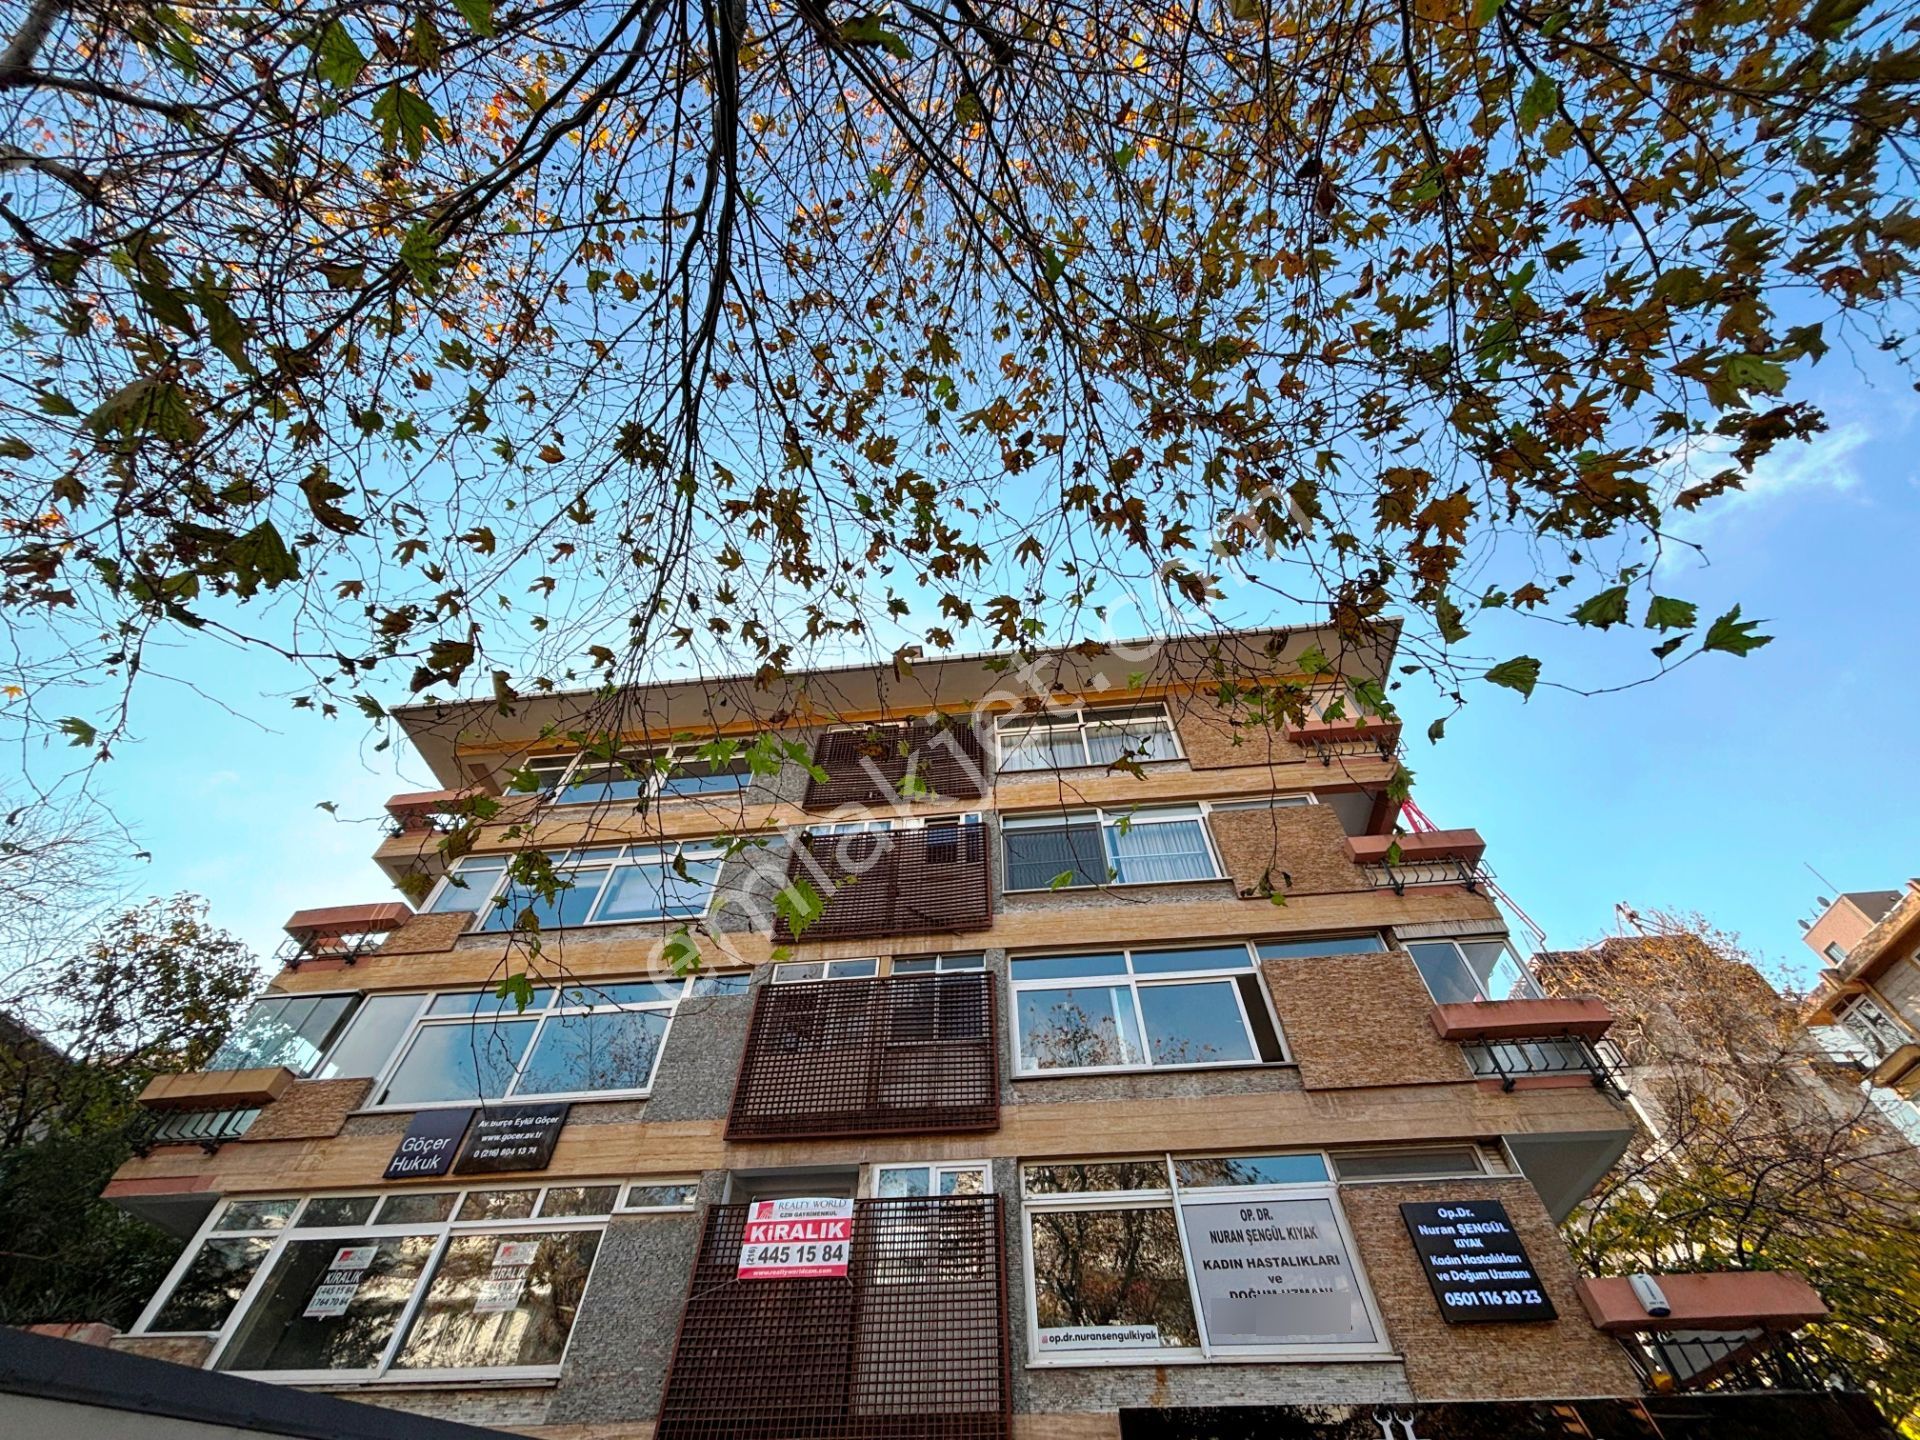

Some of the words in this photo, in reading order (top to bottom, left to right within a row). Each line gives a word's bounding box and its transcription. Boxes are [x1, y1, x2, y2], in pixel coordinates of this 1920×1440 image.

[535, 1115, 560, 1126] Göçer
[401, 1136, 451, 1154] Göçer
[390, 1154, 441, 1172] Hukuk
[778, 1200, 810, 1211] REALTY
[813, 1199, 847, 1209] WORLD
[1239, 1208, 1255, 1222] OP.
[1257, 1207, 1274, 1221] DR.
[1437, 1207, 1476, 1219] Op.Dr.
[1209, 1229, 1245, 1245] NURAN
[1246, 1225, 1286, 1246] ŞENGÜL
[1287, 1225, 1318, 1241] KIYAK
[1417, 1224, 1456, 1236] Nuran
[1456, 1221, 1510, 1236] ŞENGÜL
[1453, 1238, 1484, 1248] KIYAK
[758, 1246, 790, 1264] 445
[796, 1245, 817, 1263] 15
[822, 1244, 843, 1262] 84
[1429, 1254, 1461, 1266] Kadın
[1202, 1257, 1244, 1272] KADIN
[1246, 1254, 1341, 1269] HASTALIKLARI
[1267, 1274, 1284, 1284] ve
[1436, 1272, 1450, 1281] ve
[1451, 1270, 1490, 1283] Doğum
[1489, 1269, 1531, 1280] Uzmanı
[1444, 1290, 1479, 1306] 0501
[1479, 1290, 1503, 1305] 116
[1502, 1290, 1523, 1304] 20
[1522, 1290, 1542, 1304] 23
[1049, 1330, 1157, 1345] op.dr.nuransengulkiyak
